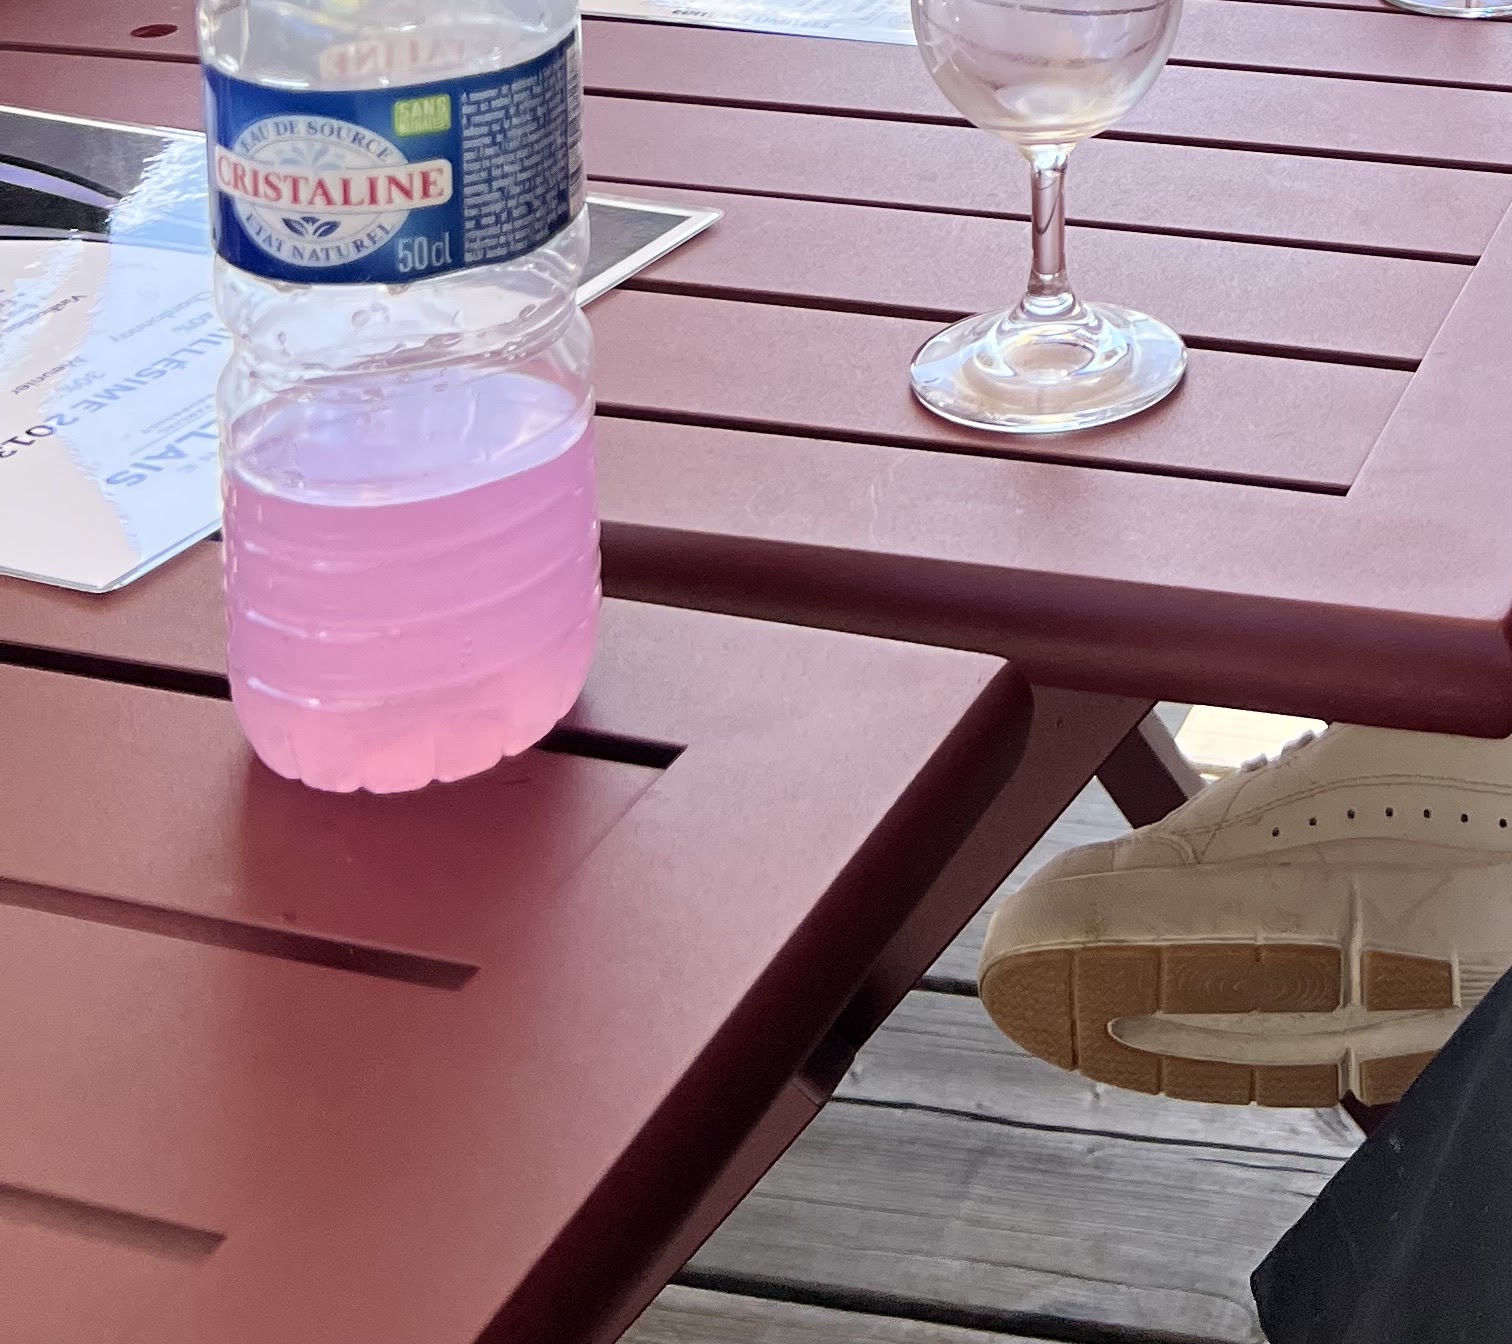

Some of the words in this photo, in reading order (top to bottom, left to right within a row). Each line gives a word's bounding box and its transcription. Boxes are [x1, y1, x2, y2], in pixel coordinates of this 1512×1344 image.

[240, 122, 270, 154] EAU
[273, 120, 299, 136] DE
[305, 120, 394, 160] SOURCE
[217, 154, 446, 208] CRISTALINE
[291, 221, 394, 263] NATUREL
[398, 231, 452, 273] 50cl
[71, 328, 232, 413] ILLÉSIME
[0, 413, 80, 459] 2013
